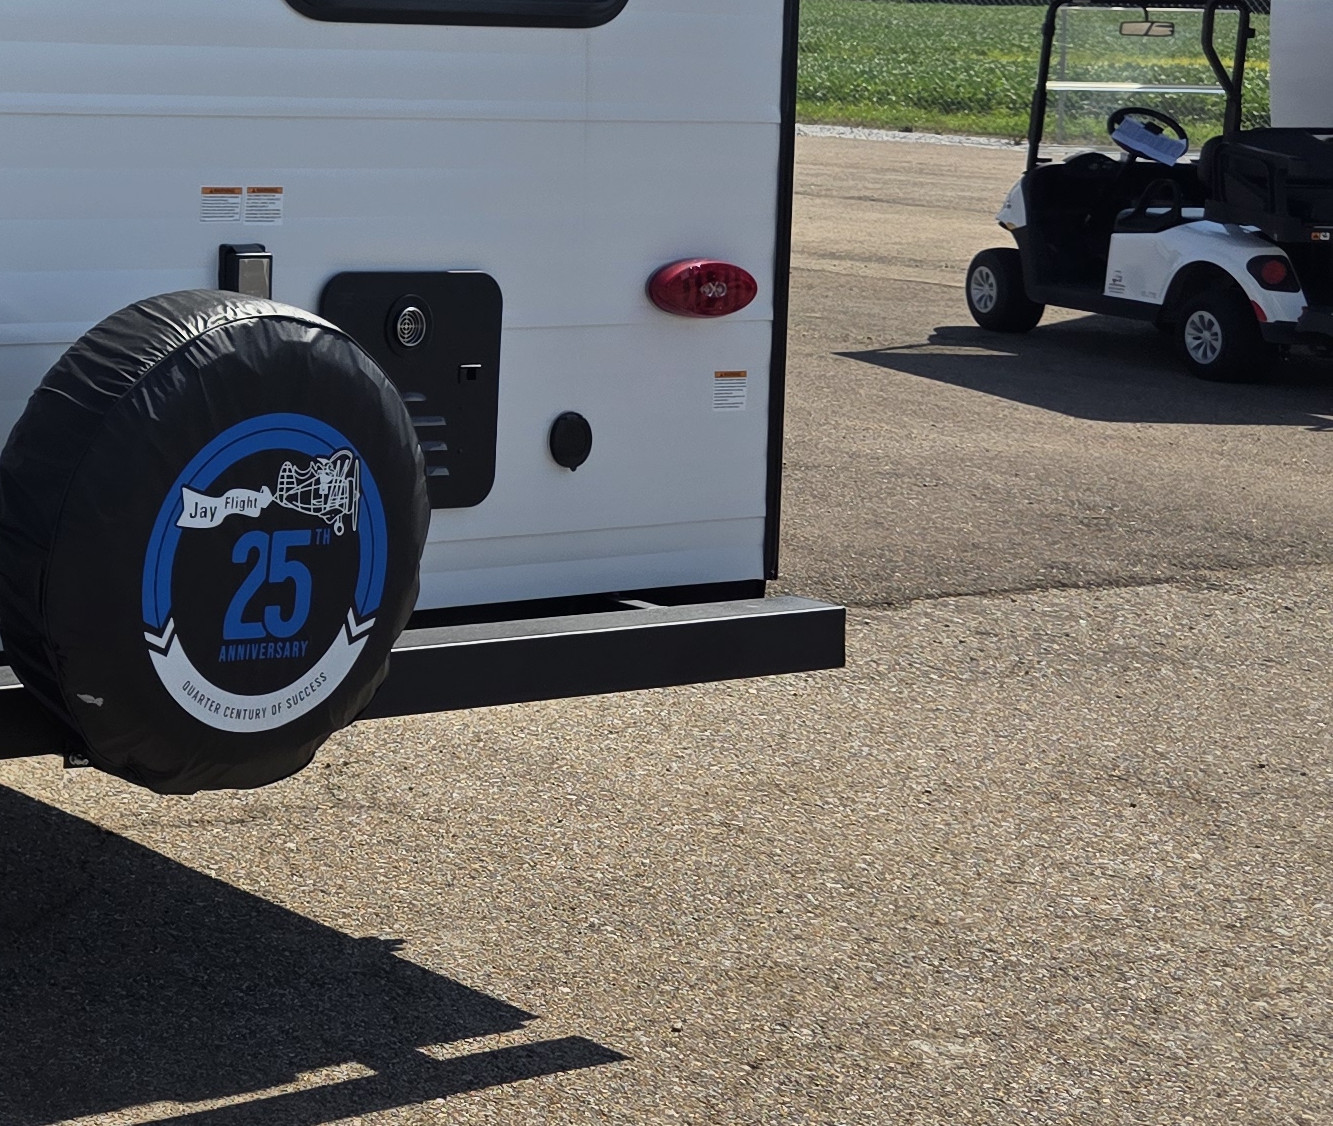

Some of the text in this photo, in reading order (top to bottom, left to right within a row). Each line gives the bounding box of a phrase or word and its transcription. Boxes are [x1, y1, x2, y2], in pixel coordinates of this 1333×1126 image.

[189, 496, 258, 522] Jay Flight
[219, 640, 308, 663] ANNIVERSARY
[182, 671, 328, 720] QUARTER CENTURY OF SUCCESS
